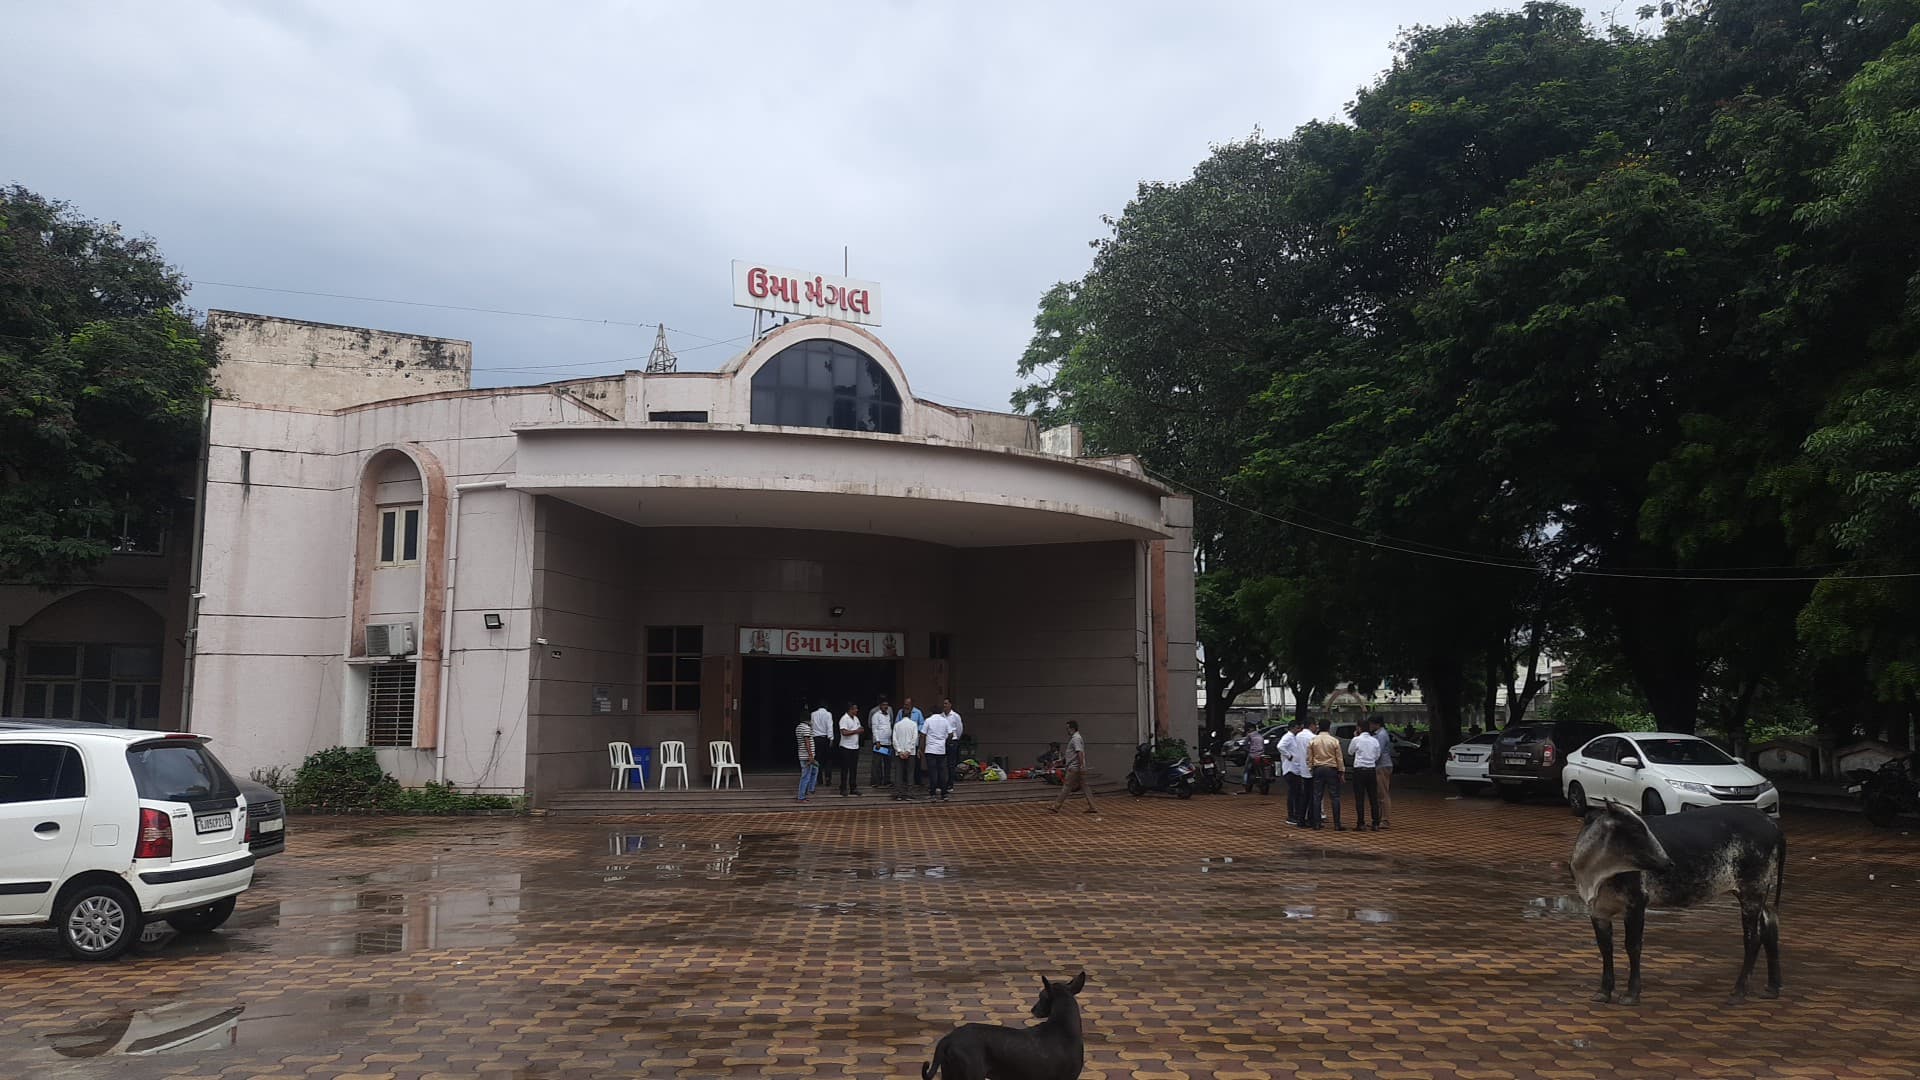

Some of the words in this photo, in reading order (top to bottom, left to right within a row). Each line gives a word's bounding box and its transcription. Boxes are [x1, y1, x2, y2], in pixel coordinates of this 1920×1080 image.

[747, 267, 800, 303] ઉમા
[805, 276, 871, 314] મંગલ
[785, 631, 821, 653] ઉમા
[825, 632, 871, 654] મંગલ
